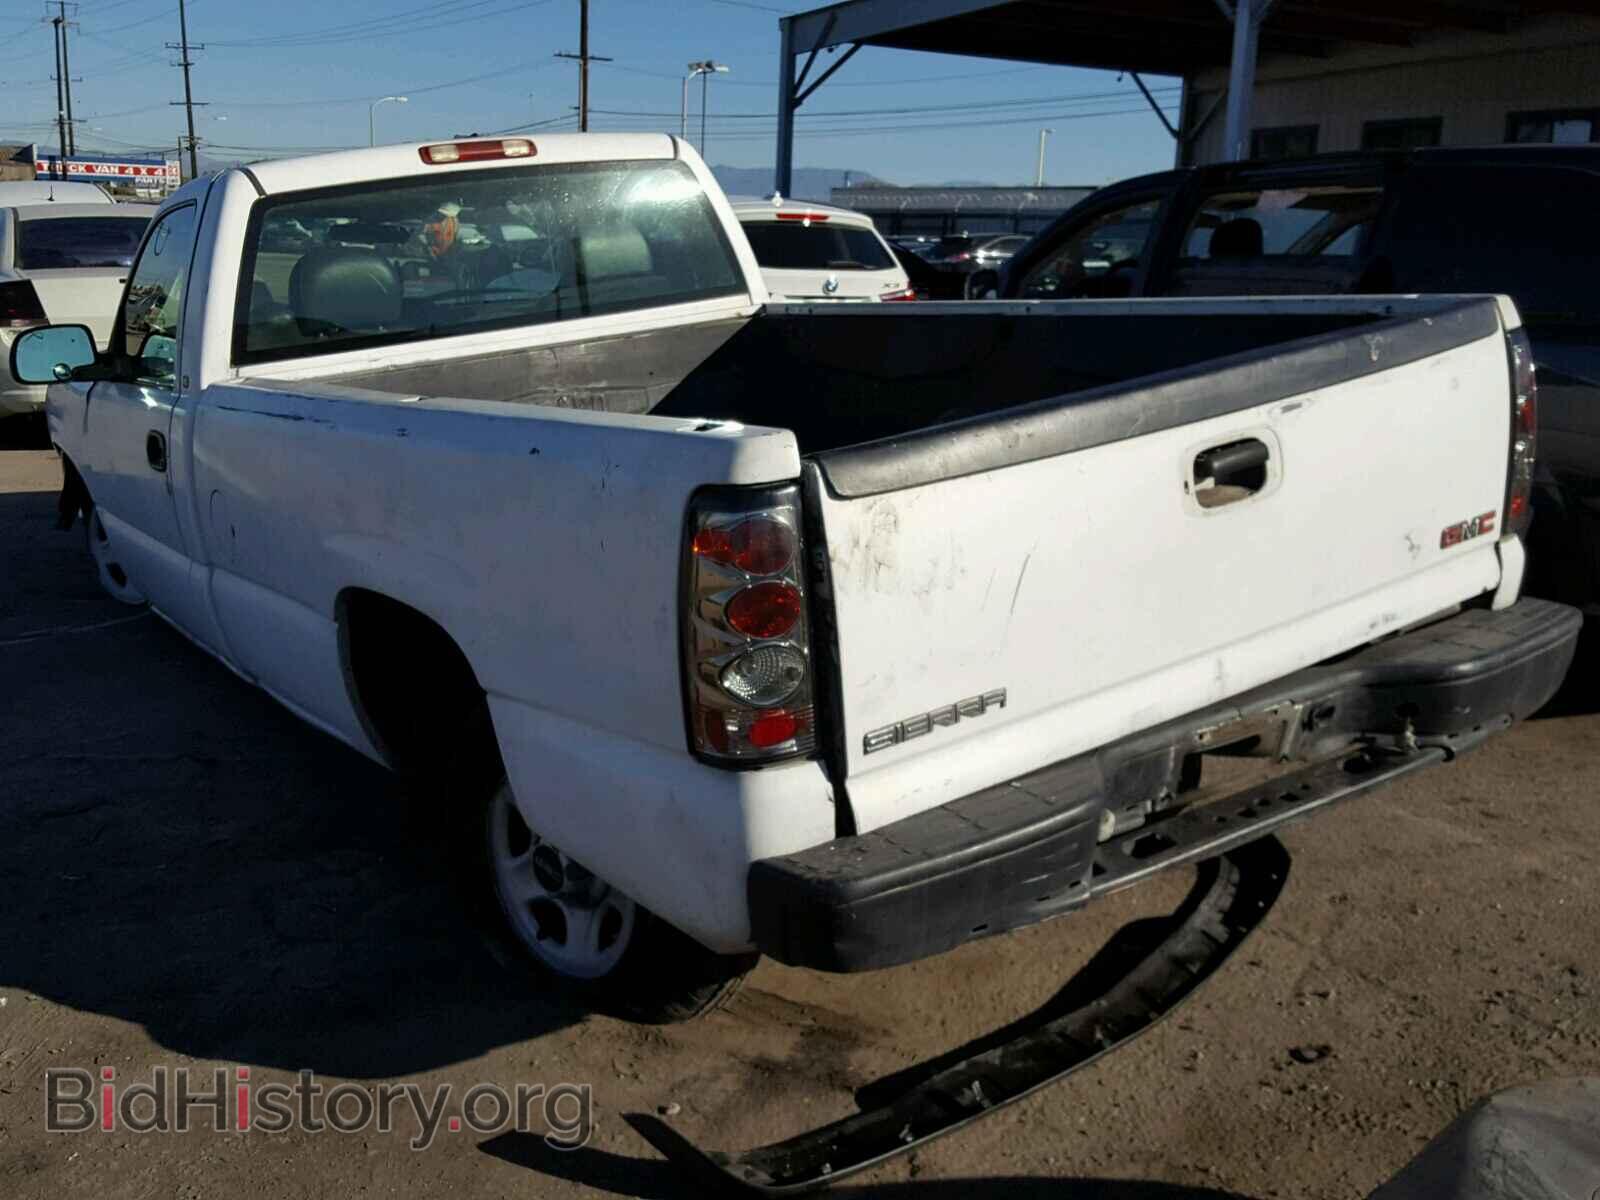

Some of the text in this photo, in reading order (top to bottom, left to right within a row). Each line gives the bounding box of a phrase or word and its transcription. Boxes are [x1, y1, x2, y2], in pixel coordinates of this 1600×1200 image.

[93, 165, 119, 174] VAN
[124, 166, 134, 175] 4
[139, 167, 149, 176] X
[153, 167, 164, 176] 4
[1440, 509, 1497, 549] GMC
[863, 687, 1006, 755] SIERRA
